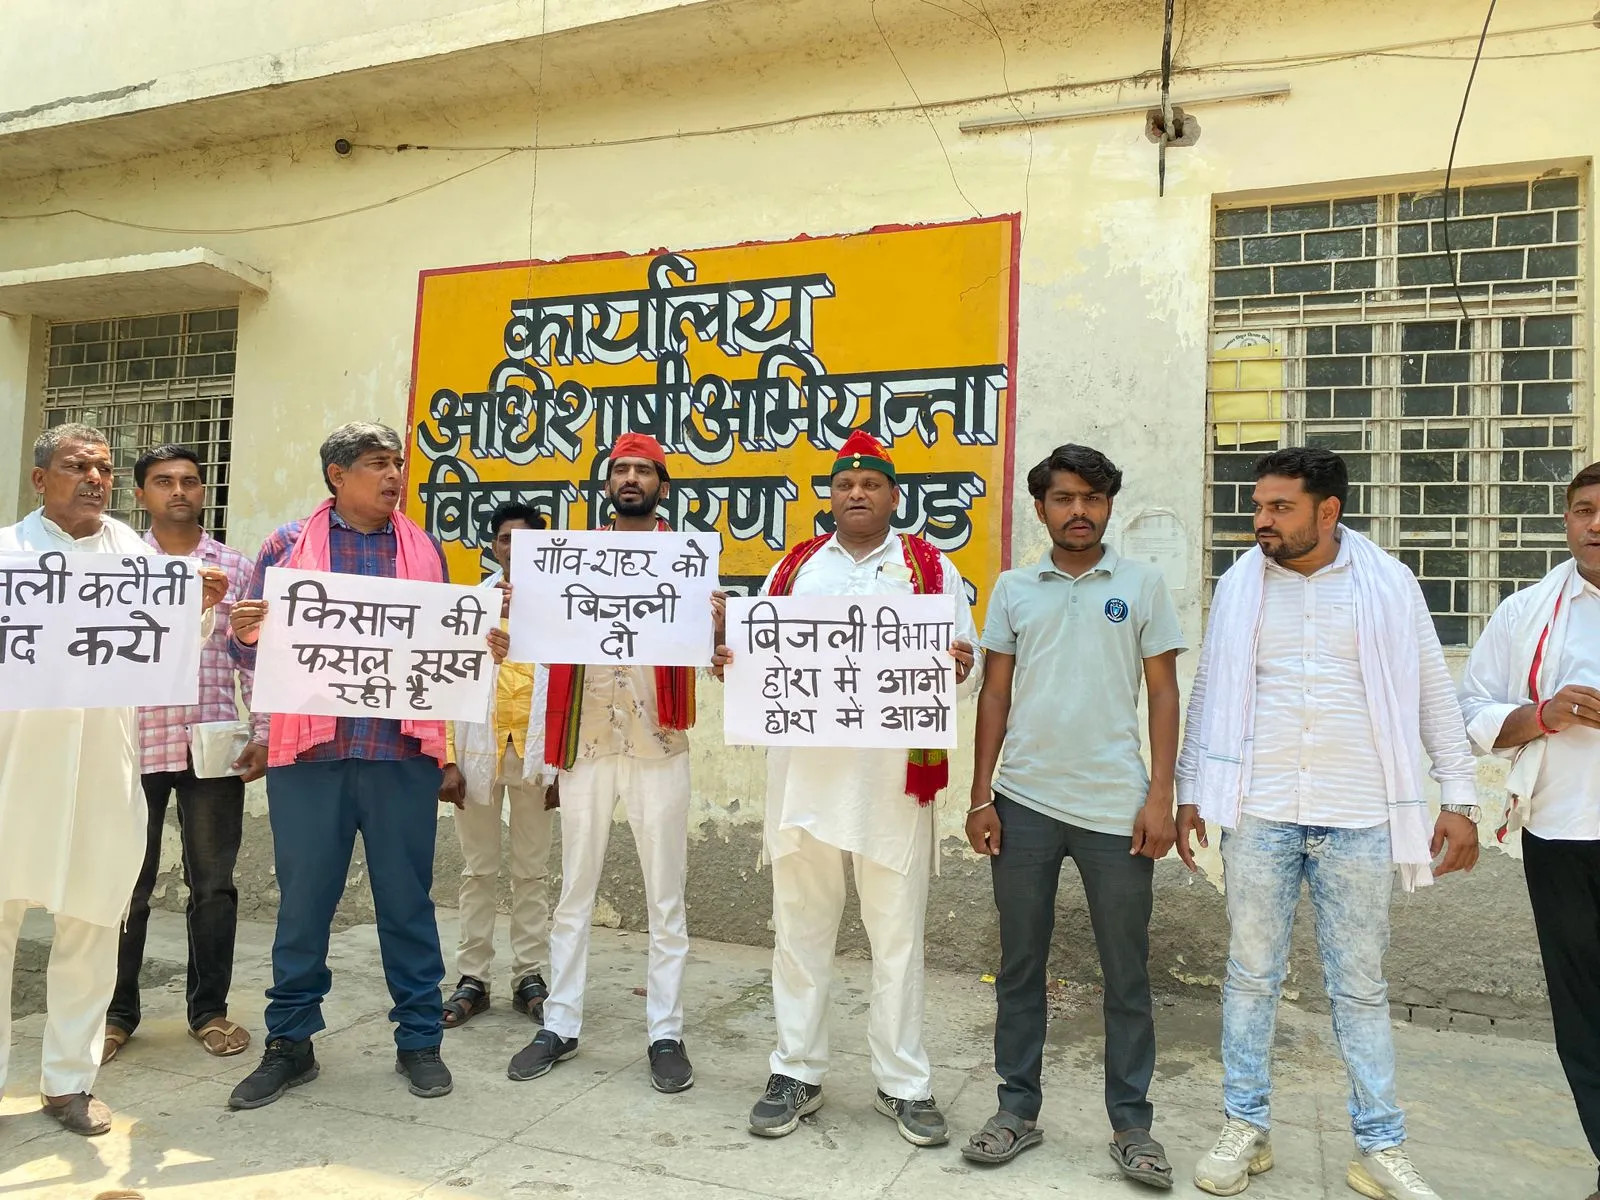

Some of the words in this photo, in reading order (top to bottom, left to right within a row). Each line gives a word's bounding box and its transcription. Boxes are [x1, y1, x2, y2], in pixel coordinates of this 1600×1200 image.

[504, 253, 835, 366] कार्यालय
[672, 538, 709, 578] को
[78, 556, 194, 608] कटौती
[561, 582, 681, 623] बिजली
[280, 580, 421, 639] किसान
[441, 595, 487, 635] की
[741, 600, 867, 654] बिजली
[871, 605, 953, 652] विभाग
[67, 610, 170, 665] करो
[600, 621, 638, 659] दो
[292, 644, 393, 675] फसल
[411, 650, 487, 684] सूख
[762, 655, 821, 698] होश
[834, 655, 861, 693] में
[877, 656, 951, 695] आओ
[328, 676, 397, 708] रही
[406, 674, 432, 710] है
[765, 701, 817, 734] होश
[835, 696, 864, 729] में
[881, 695, 950, 732] आओ
